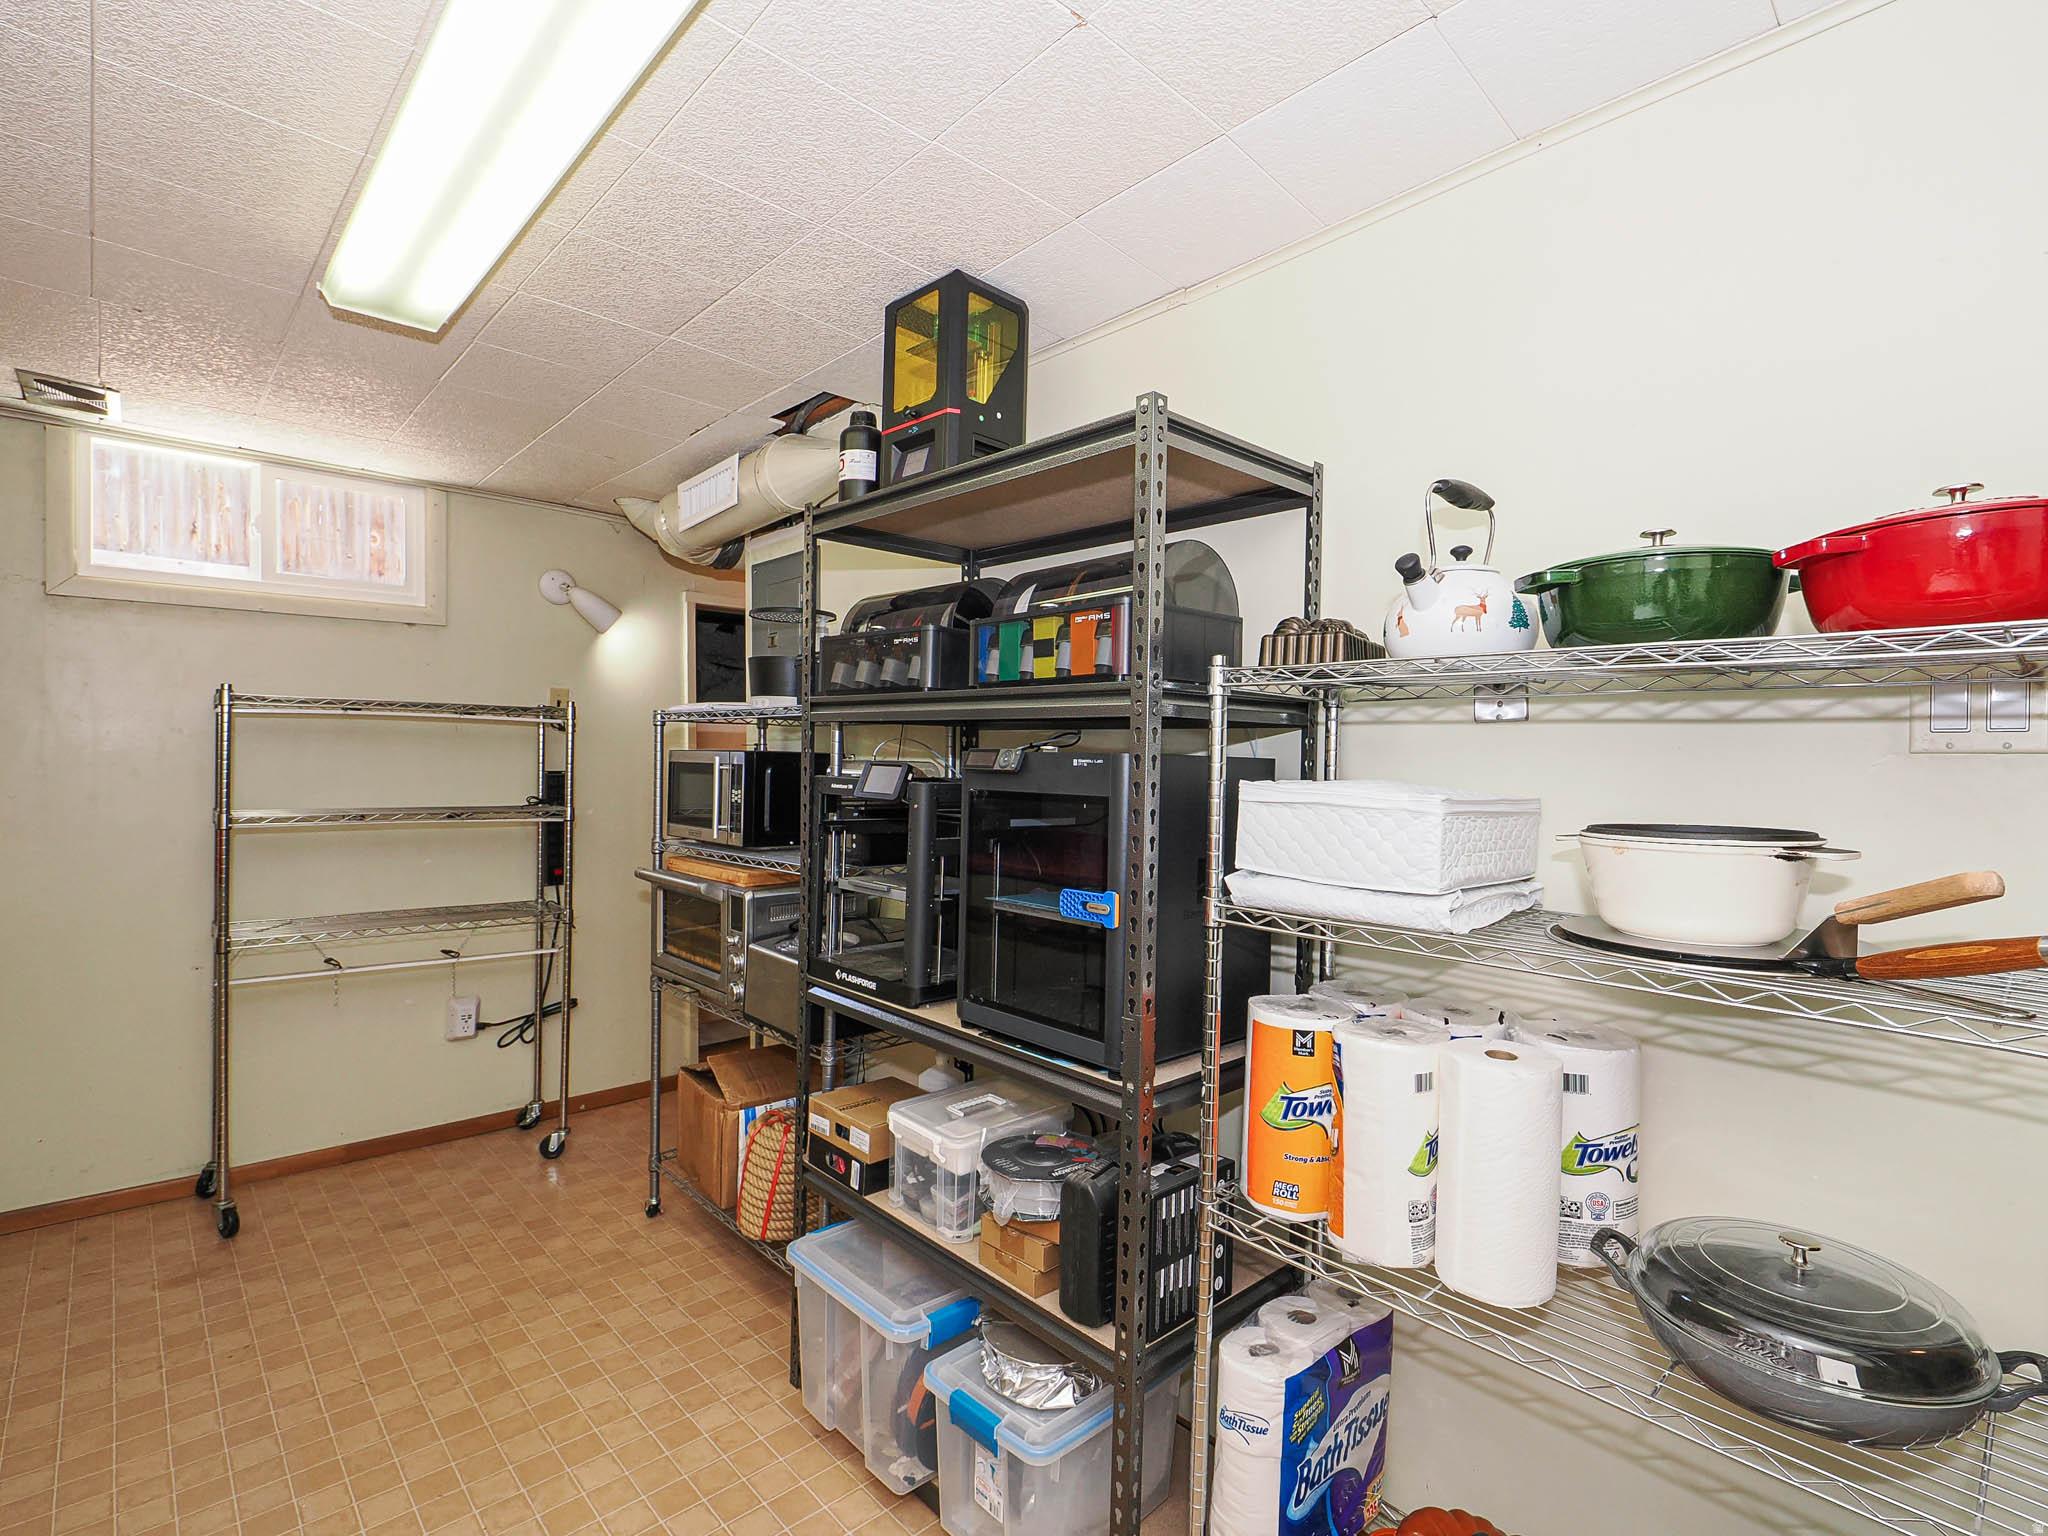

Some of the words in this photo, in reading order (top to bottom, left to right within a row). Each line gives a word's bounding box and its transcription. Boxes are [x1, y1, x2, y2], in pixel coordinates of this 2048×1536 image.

[1088, 612, 1111, 621] AMS
[841, 972, 877, 990] FLASHFORGE
[1279, 1095, 1333, 1121] Tow
[1284, 1153, 1308, 1164] Strong
[1274, 1181, 1299, 1192] MEGA
[1273, 1188, 1299, 1200] ROLL
